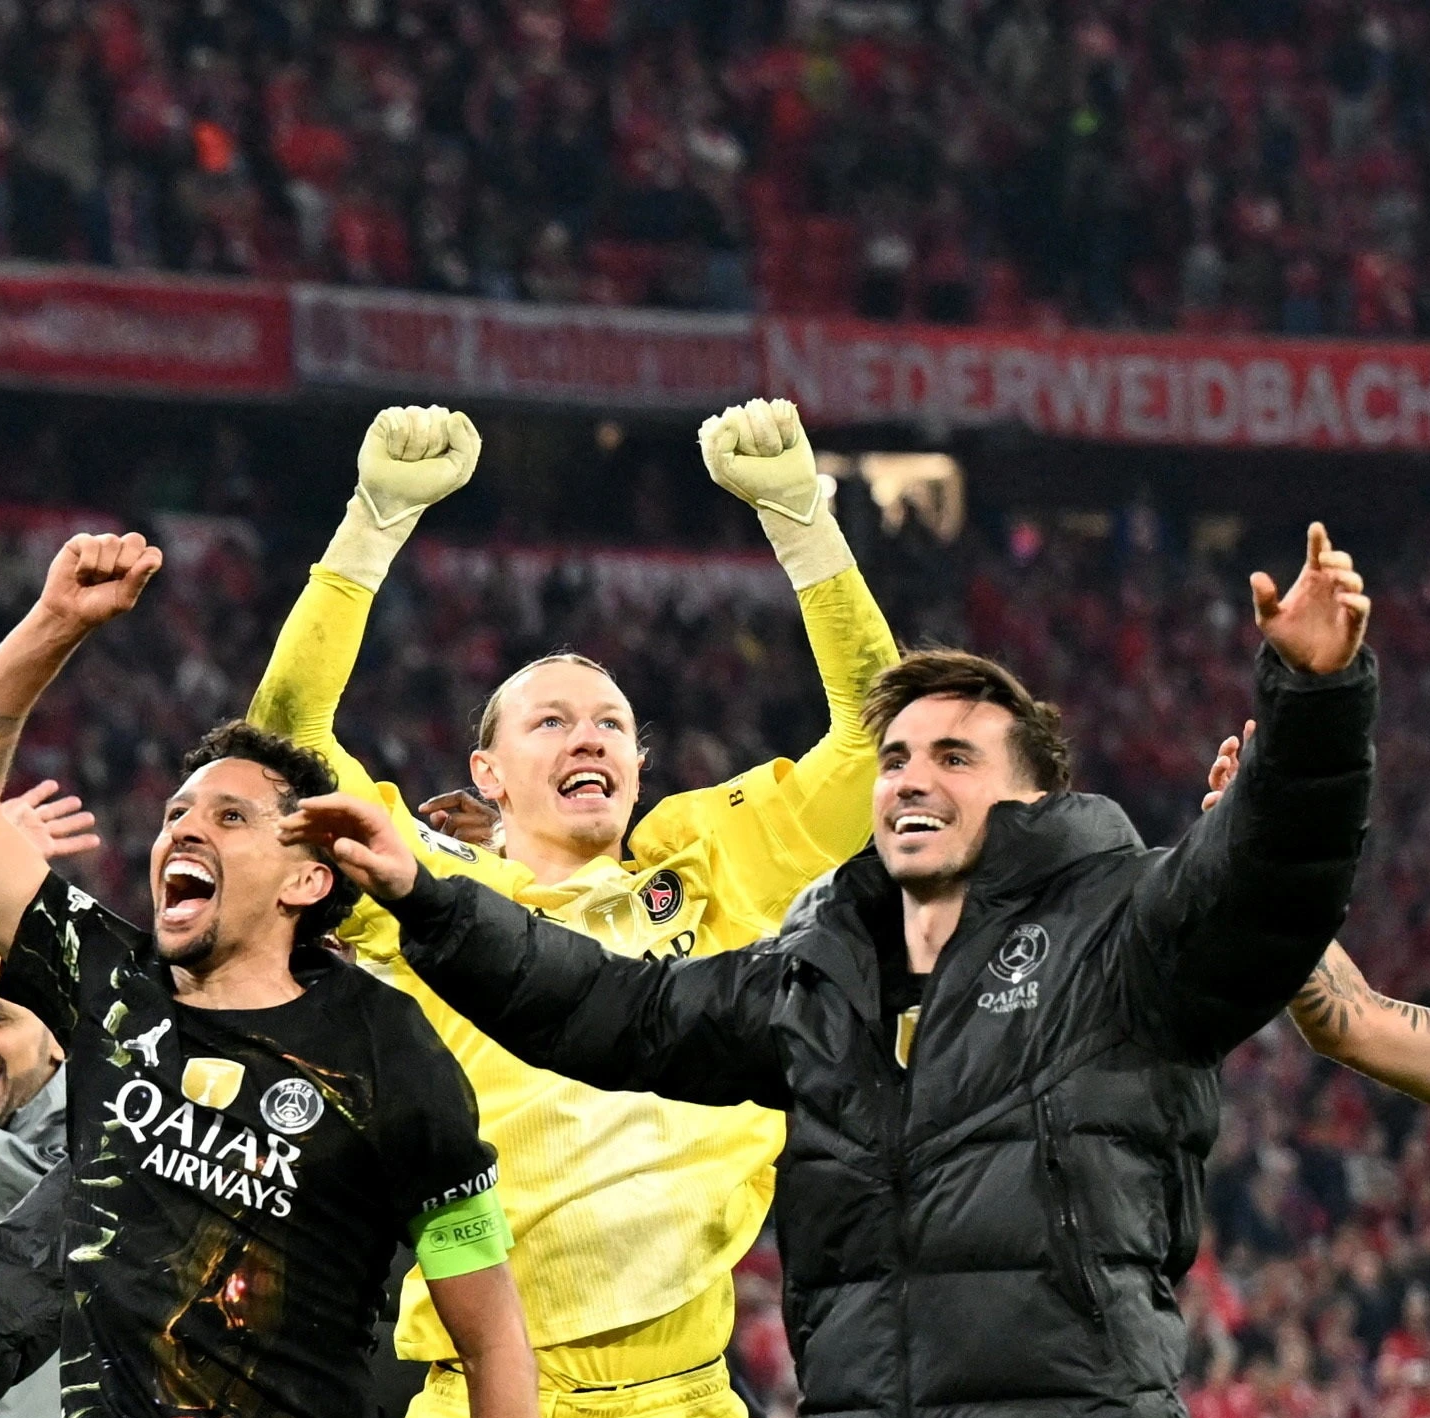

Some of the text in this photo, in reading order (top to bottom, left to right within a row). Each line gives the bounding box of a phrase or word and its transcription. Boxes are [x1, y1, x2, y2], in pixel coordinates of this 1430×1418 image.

[977, 981, 1039, 1009] QATAR
[114, 1079, 302, 1189] QATAR
[140, 1143, 294, 1218] AIRWAYS
